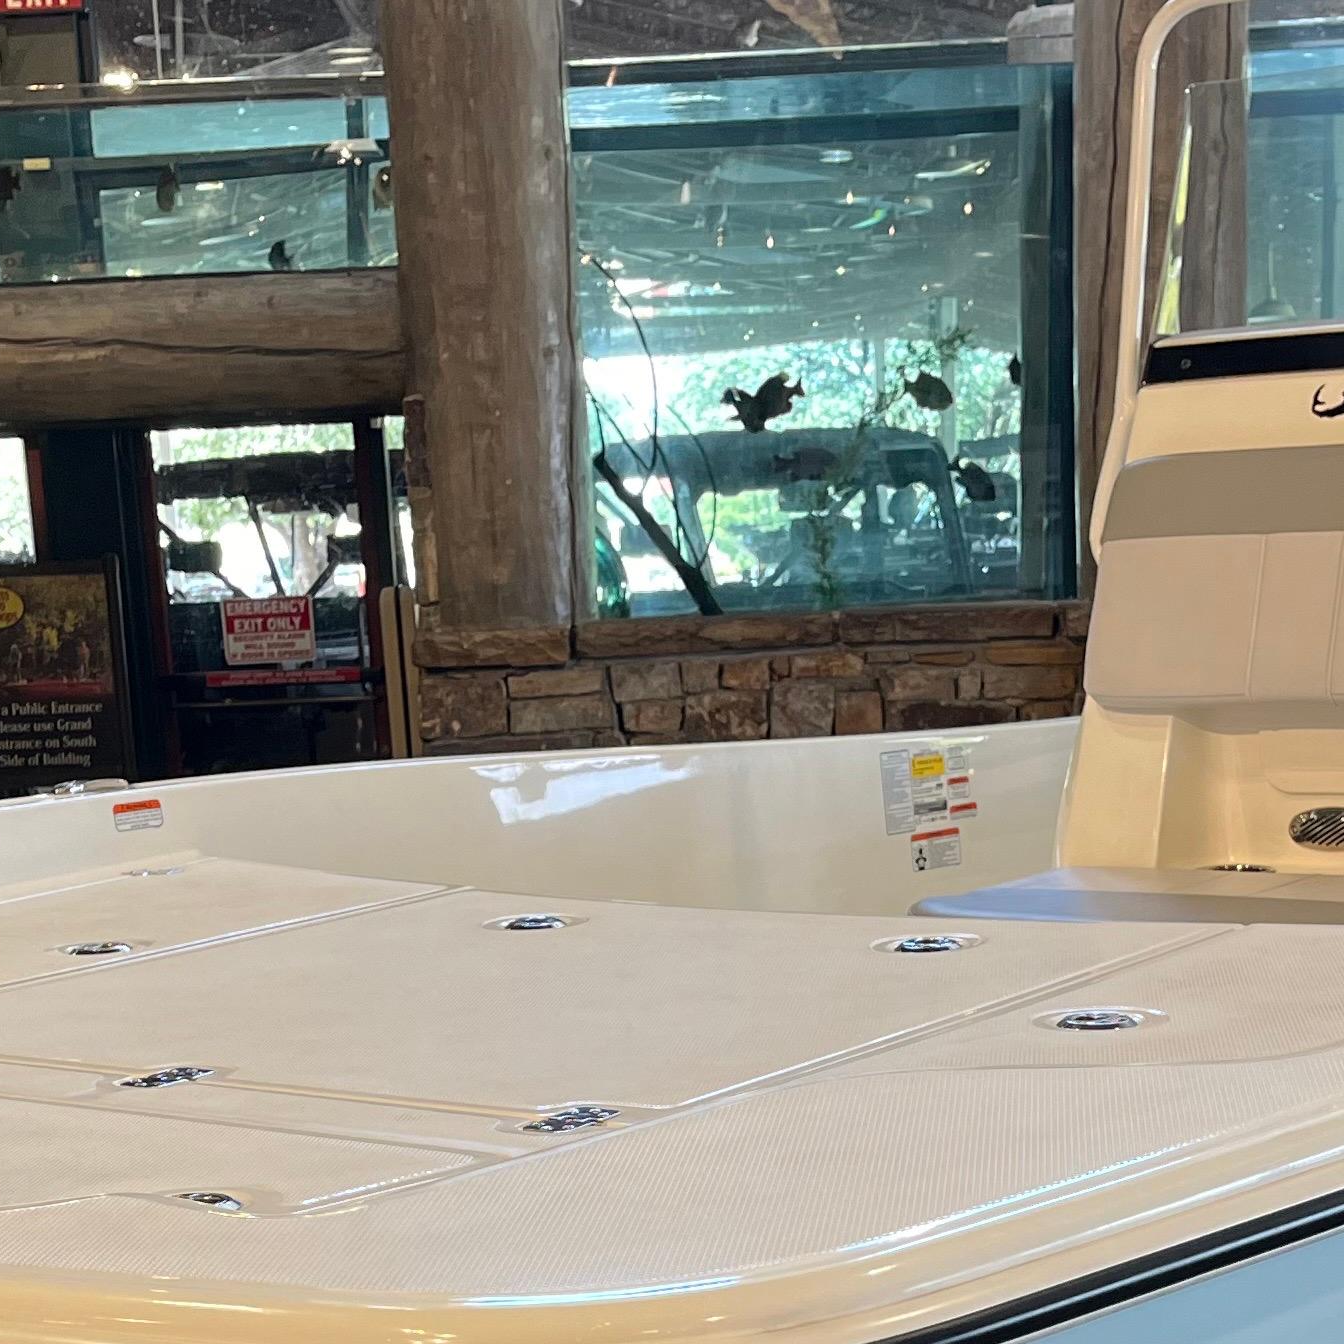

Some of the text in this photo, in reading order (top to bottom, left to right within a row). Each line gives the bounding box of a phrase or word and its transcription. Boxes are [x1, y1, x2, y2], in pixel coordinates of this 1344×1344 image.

[226, 599, 306, 616] EMERGENCY
[233, 615, 301, 633] EXIT ONLY
[1, 706, 8, 716] a
[11, 702, 47, 715] Public
[51, 701, 103, 715] Entrance
[33, 722, 55, 732] use
[56, 717, 92, 731] Grand
[45, 738, 60, 749] on
[63, 735, 97, 748] South
[0, 752, 92, 768] Side of Building
